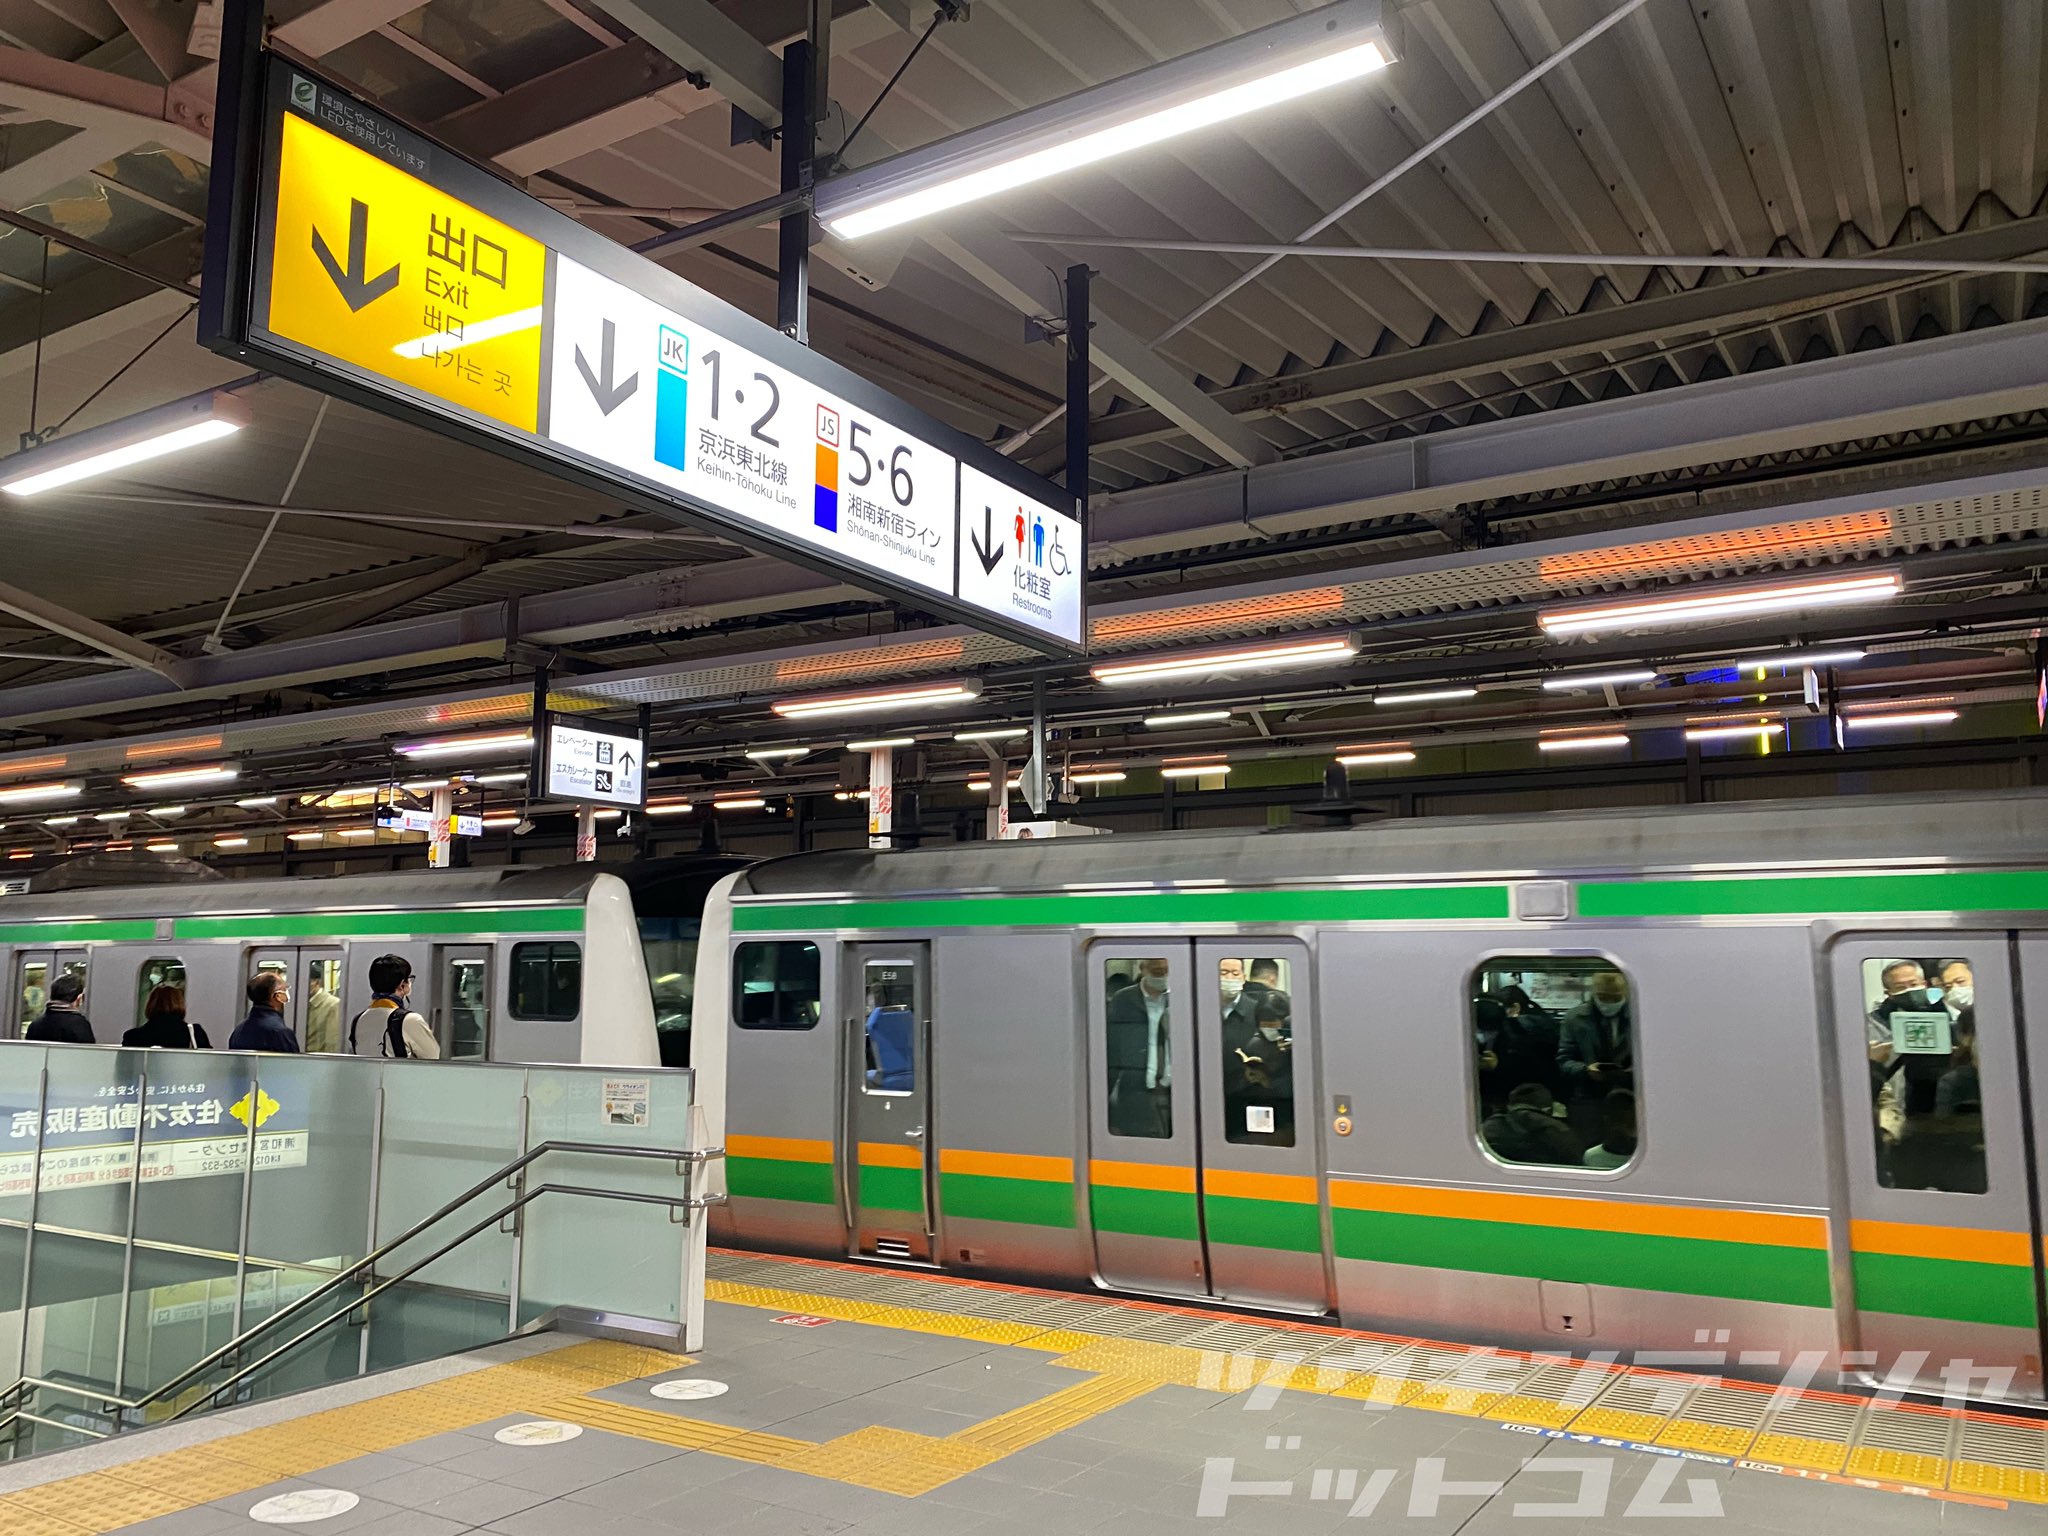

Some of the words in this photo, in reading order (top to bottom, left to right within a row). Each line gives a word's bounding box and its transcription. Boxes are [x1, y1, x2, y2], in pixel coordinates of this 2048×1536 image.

[320, 106, 426, 170] LEDを使用しています
[321, 92, 396, 141] 環境にやさしい
[427, 211, 508, 290] 出口
[425, 266, 470, 310] Exit
[423, 304, 465, 342] 出口
[421, 342, 485, 385] 나가는
[493, 369, 512, 397] 곳
[663, 337, 684, 363] JK
[820, 415, 835, 437] JS
[698, 427, 788, 487] 京浜東北線
[697, 456, 773, 500] Keihin-Tōhoku
[775, 491, 797, 510] Line
[846, 519, 918, 560] Shōnan-Shinjuku
[918, 547, 936, 567] Line
[847, 492, 942, 549] 湘南新宿ライン
[1013, 564, 1051, 601] 化粧室
[1012, 592, 1052, 620] Restrooms
[556, 734, 594, 748] エレベーター
[556, 763, 593, 777] エスカレーター
